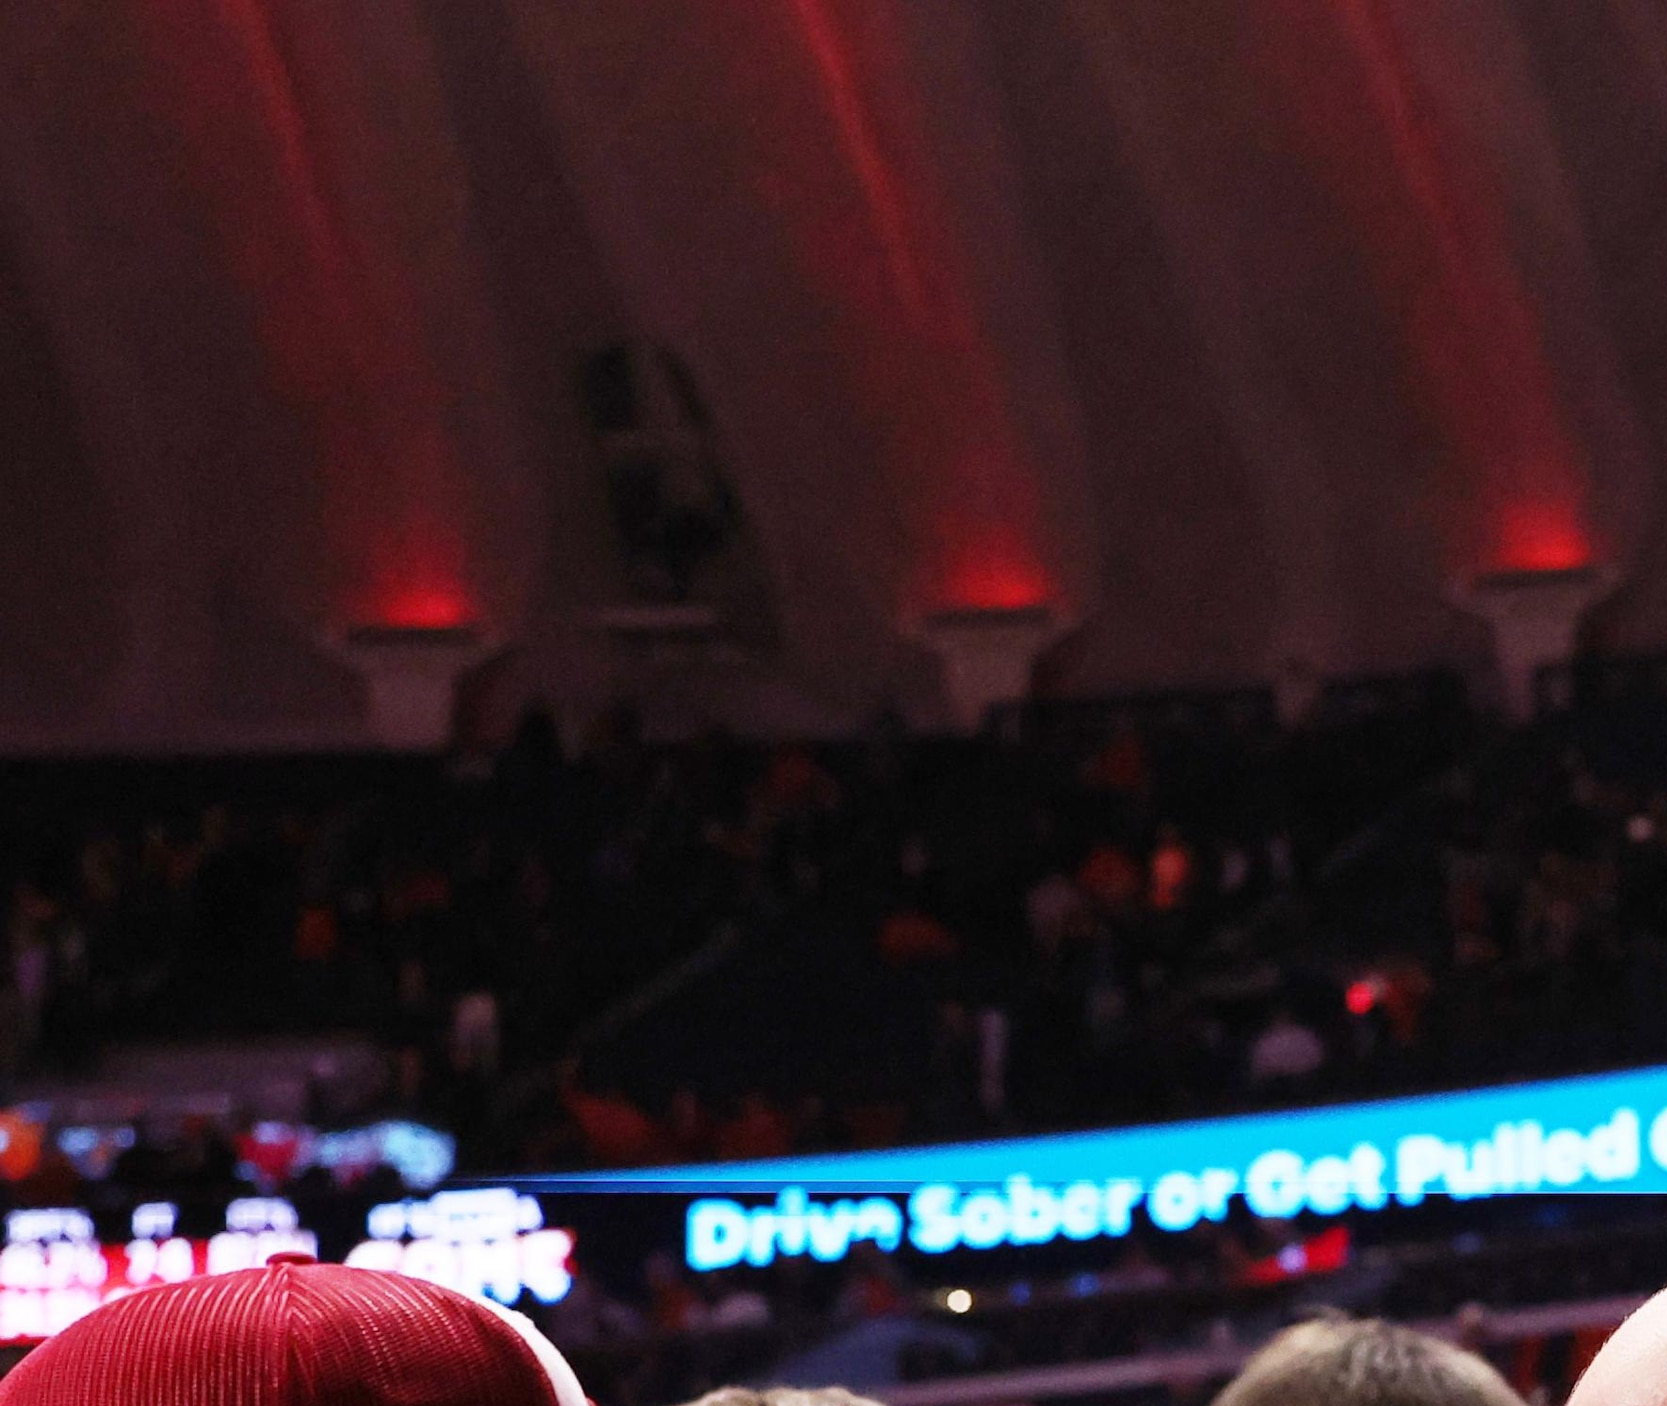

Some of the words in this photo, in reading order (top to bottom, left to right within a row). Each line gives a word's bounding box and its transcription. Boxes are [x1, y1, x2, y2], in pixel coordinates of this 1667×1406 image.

[908, 1173, 1142, 1253] Sober
[1146, 1168, 1238, 1231] or
[1244, 1142, 1386, 1219] Get
[1396, 1108, 1641, 1206] Pulled
